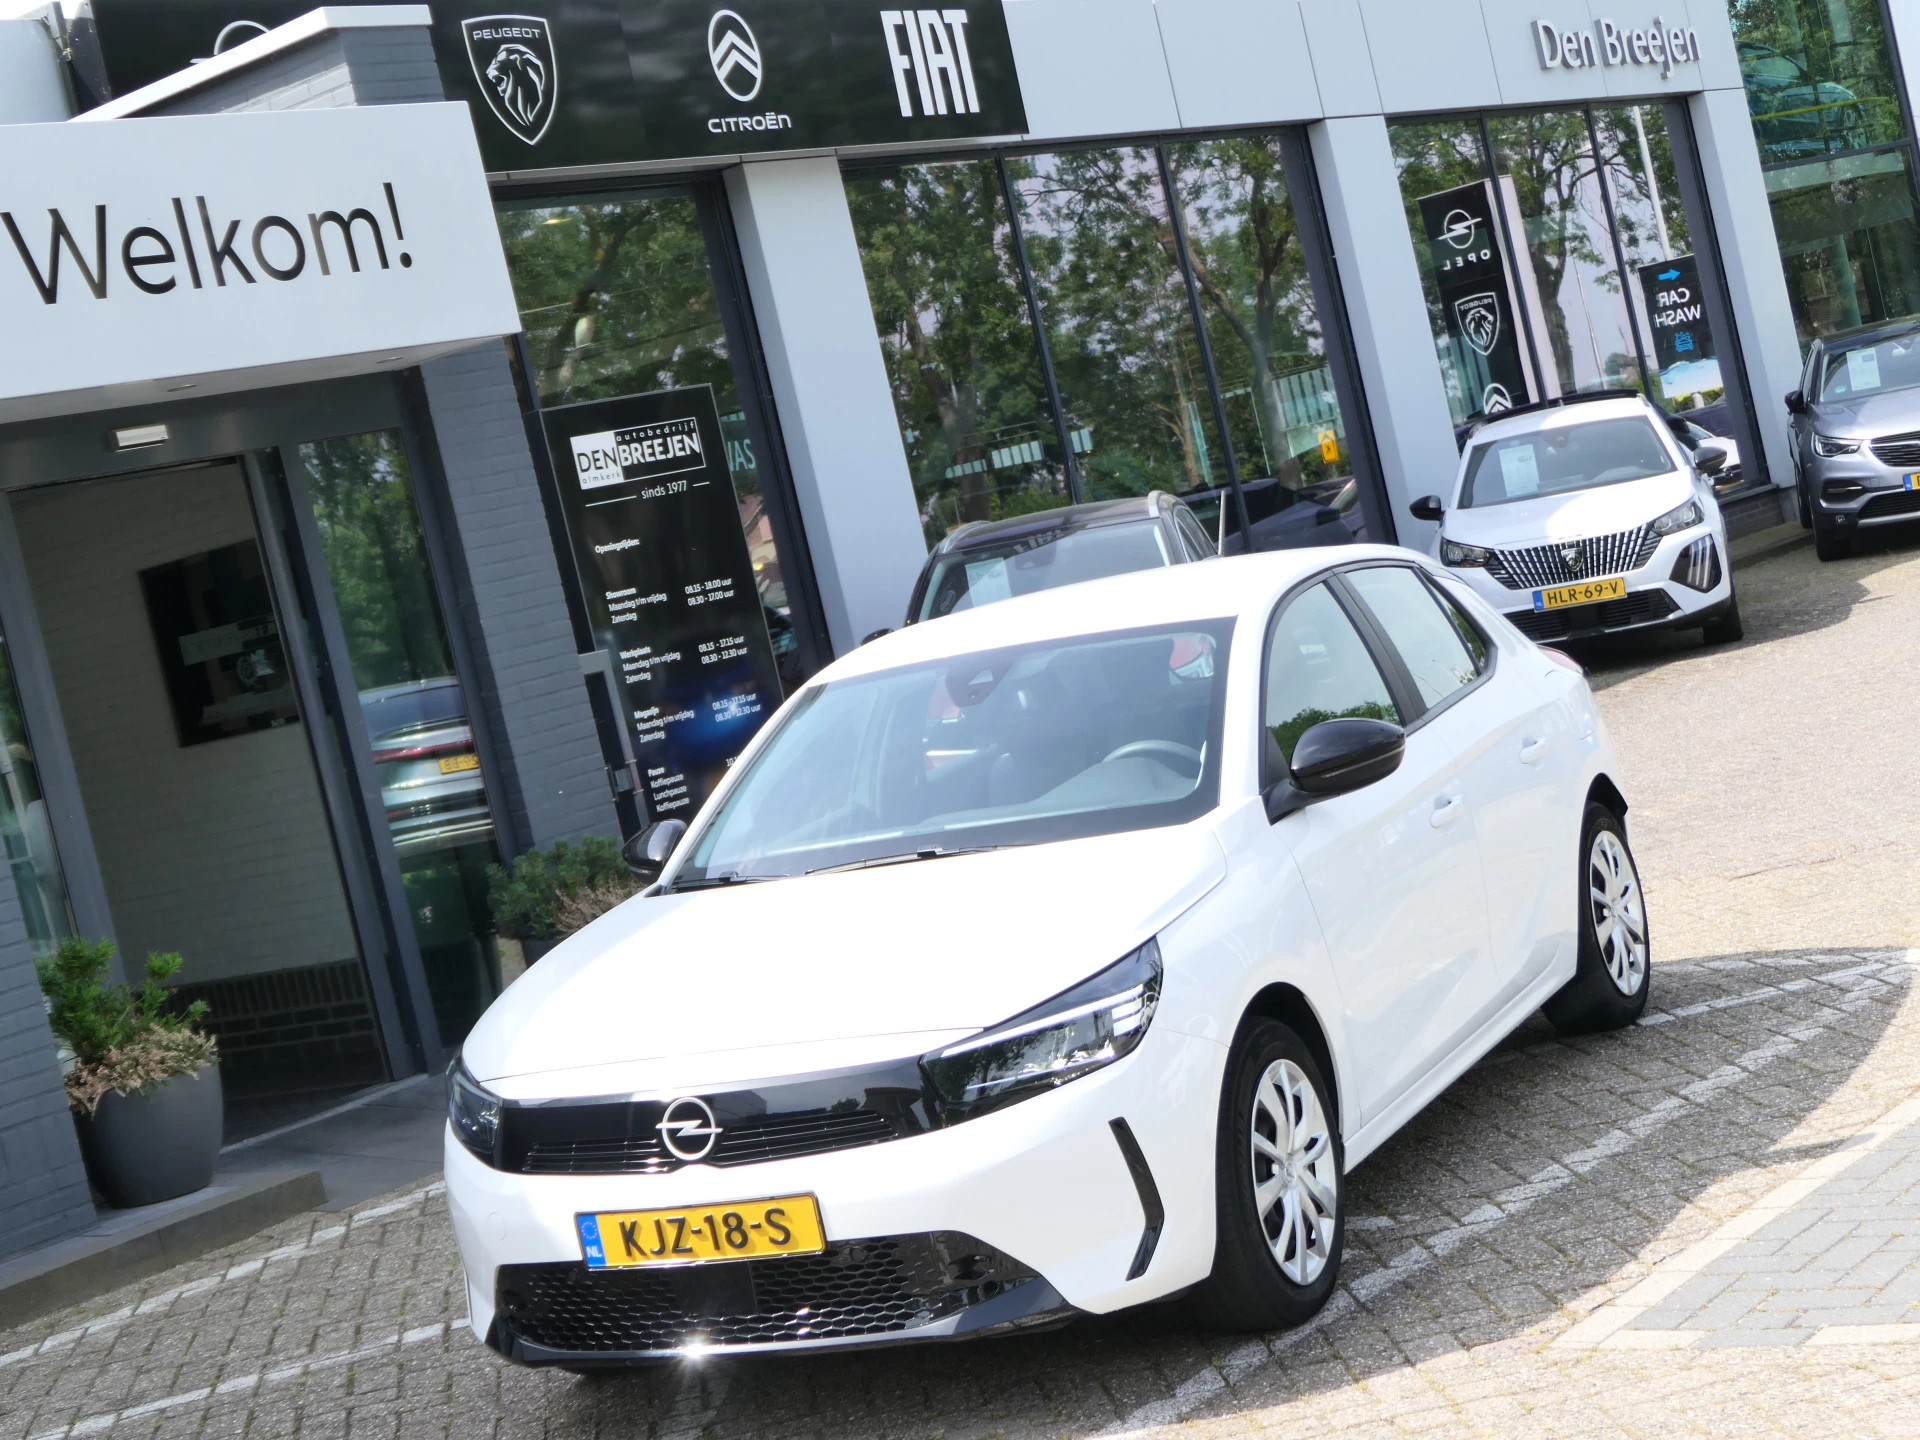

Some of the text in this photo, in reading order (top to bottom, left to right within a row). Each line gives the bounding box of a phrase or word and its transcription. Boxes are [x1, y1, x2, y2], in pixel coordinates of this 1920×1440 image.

[472, 26, 541, 40] PEUGEOT
[1530, 15, 1702, 80] Den Breejen
[880, 9, 981, 117] FIAT
[0, 182, 414, 305] Welkom!
[616, 421, 695, 442] autobedrijf
[576, 433, 700, 473] DEN BREEJEN
[582, 471, 622, 484] almkerk
[641, 480, 688, 500] sinds 1977
[721, 578, 732, 587] uur
[605, 587, 637, 600] Showroom
[724, 589, 735, 598] uur
[1547, 581, 1618, 605] HLR-69-V
[608, 599, 636, 612] Maandag
[646, 592, 668, 605] vrijdag
[611, 611, 638, 624] Zaterdag
[733, 635, 745, 644] uur
[737, 647, 748, 656] uur
[622, 658, 650, 672] Maandag
[660, 651, 681, 663] vrijdag
[625, 671, 651, 684] Zaterdag
[746, 693, 757, 701] uur
[750, 704, 761, 713] uur
[637, 717, 664, 731] Maandag
[674, 709, 695, 721] vrijdag
[639, 730, 665, 743] Zaterdag
[653, 785, 687, 801] Lunchpauze
[585, 1207, 792, 1258] NL KJZ-18-S
